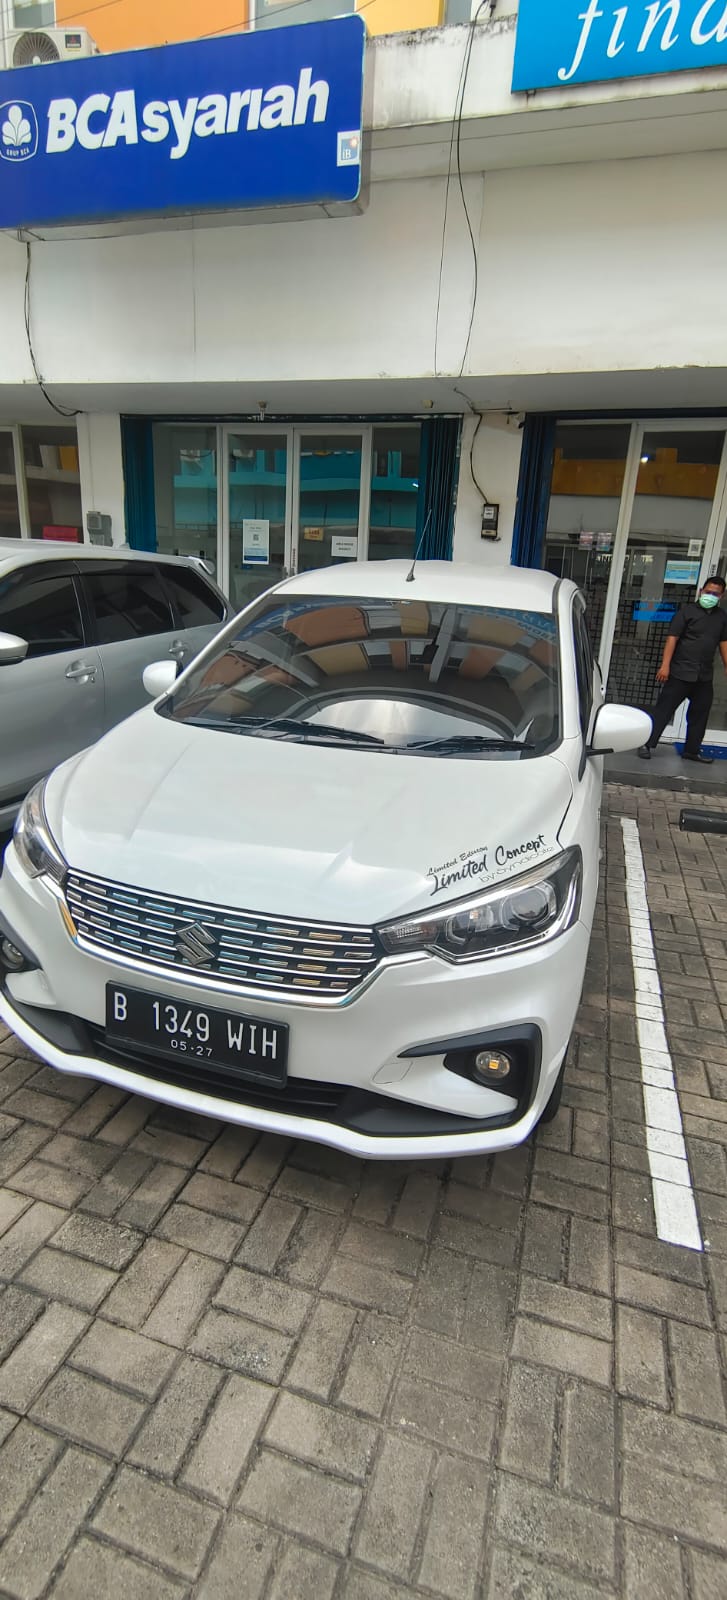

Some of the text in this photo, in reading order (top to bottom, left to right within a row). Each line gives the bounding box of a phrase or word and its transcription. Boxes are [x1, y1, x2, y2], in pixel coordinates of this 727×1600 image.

[426, 858, 458, 877] Limited
[430, 833, 546, 896] Limited Concept
[114, 991, 277, 1060] B 1349 WIH
